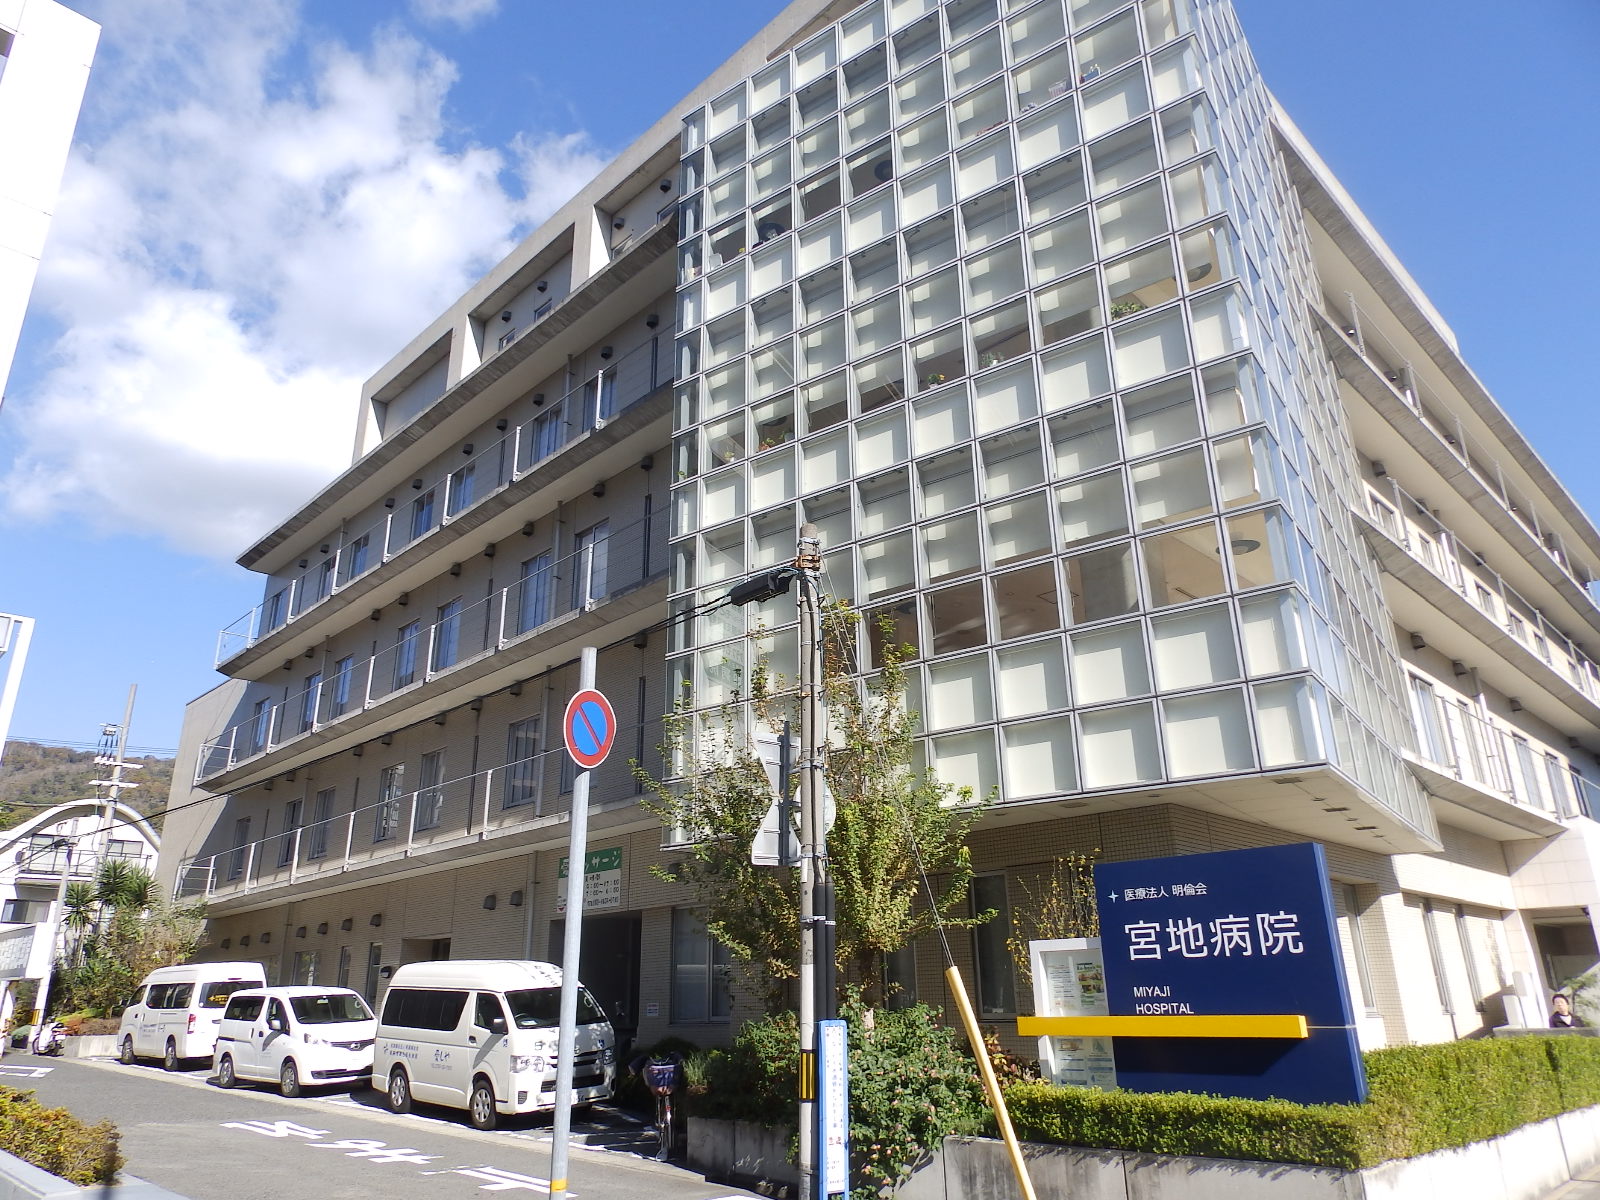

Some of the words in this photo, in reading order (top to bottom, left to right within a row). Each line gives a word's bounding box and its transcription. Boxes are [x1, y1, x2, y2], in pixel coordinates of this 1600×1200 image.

[1124, 886, 1169, 901] 医療法人
[1171, 882, 1207, 897] 明倫会
[1124, 911, 1304, 960] 宮地病院
[1133, 986, 1171, 998] MIYAJI
[1135, 1003, 1194, 1015] HOSPITAL
